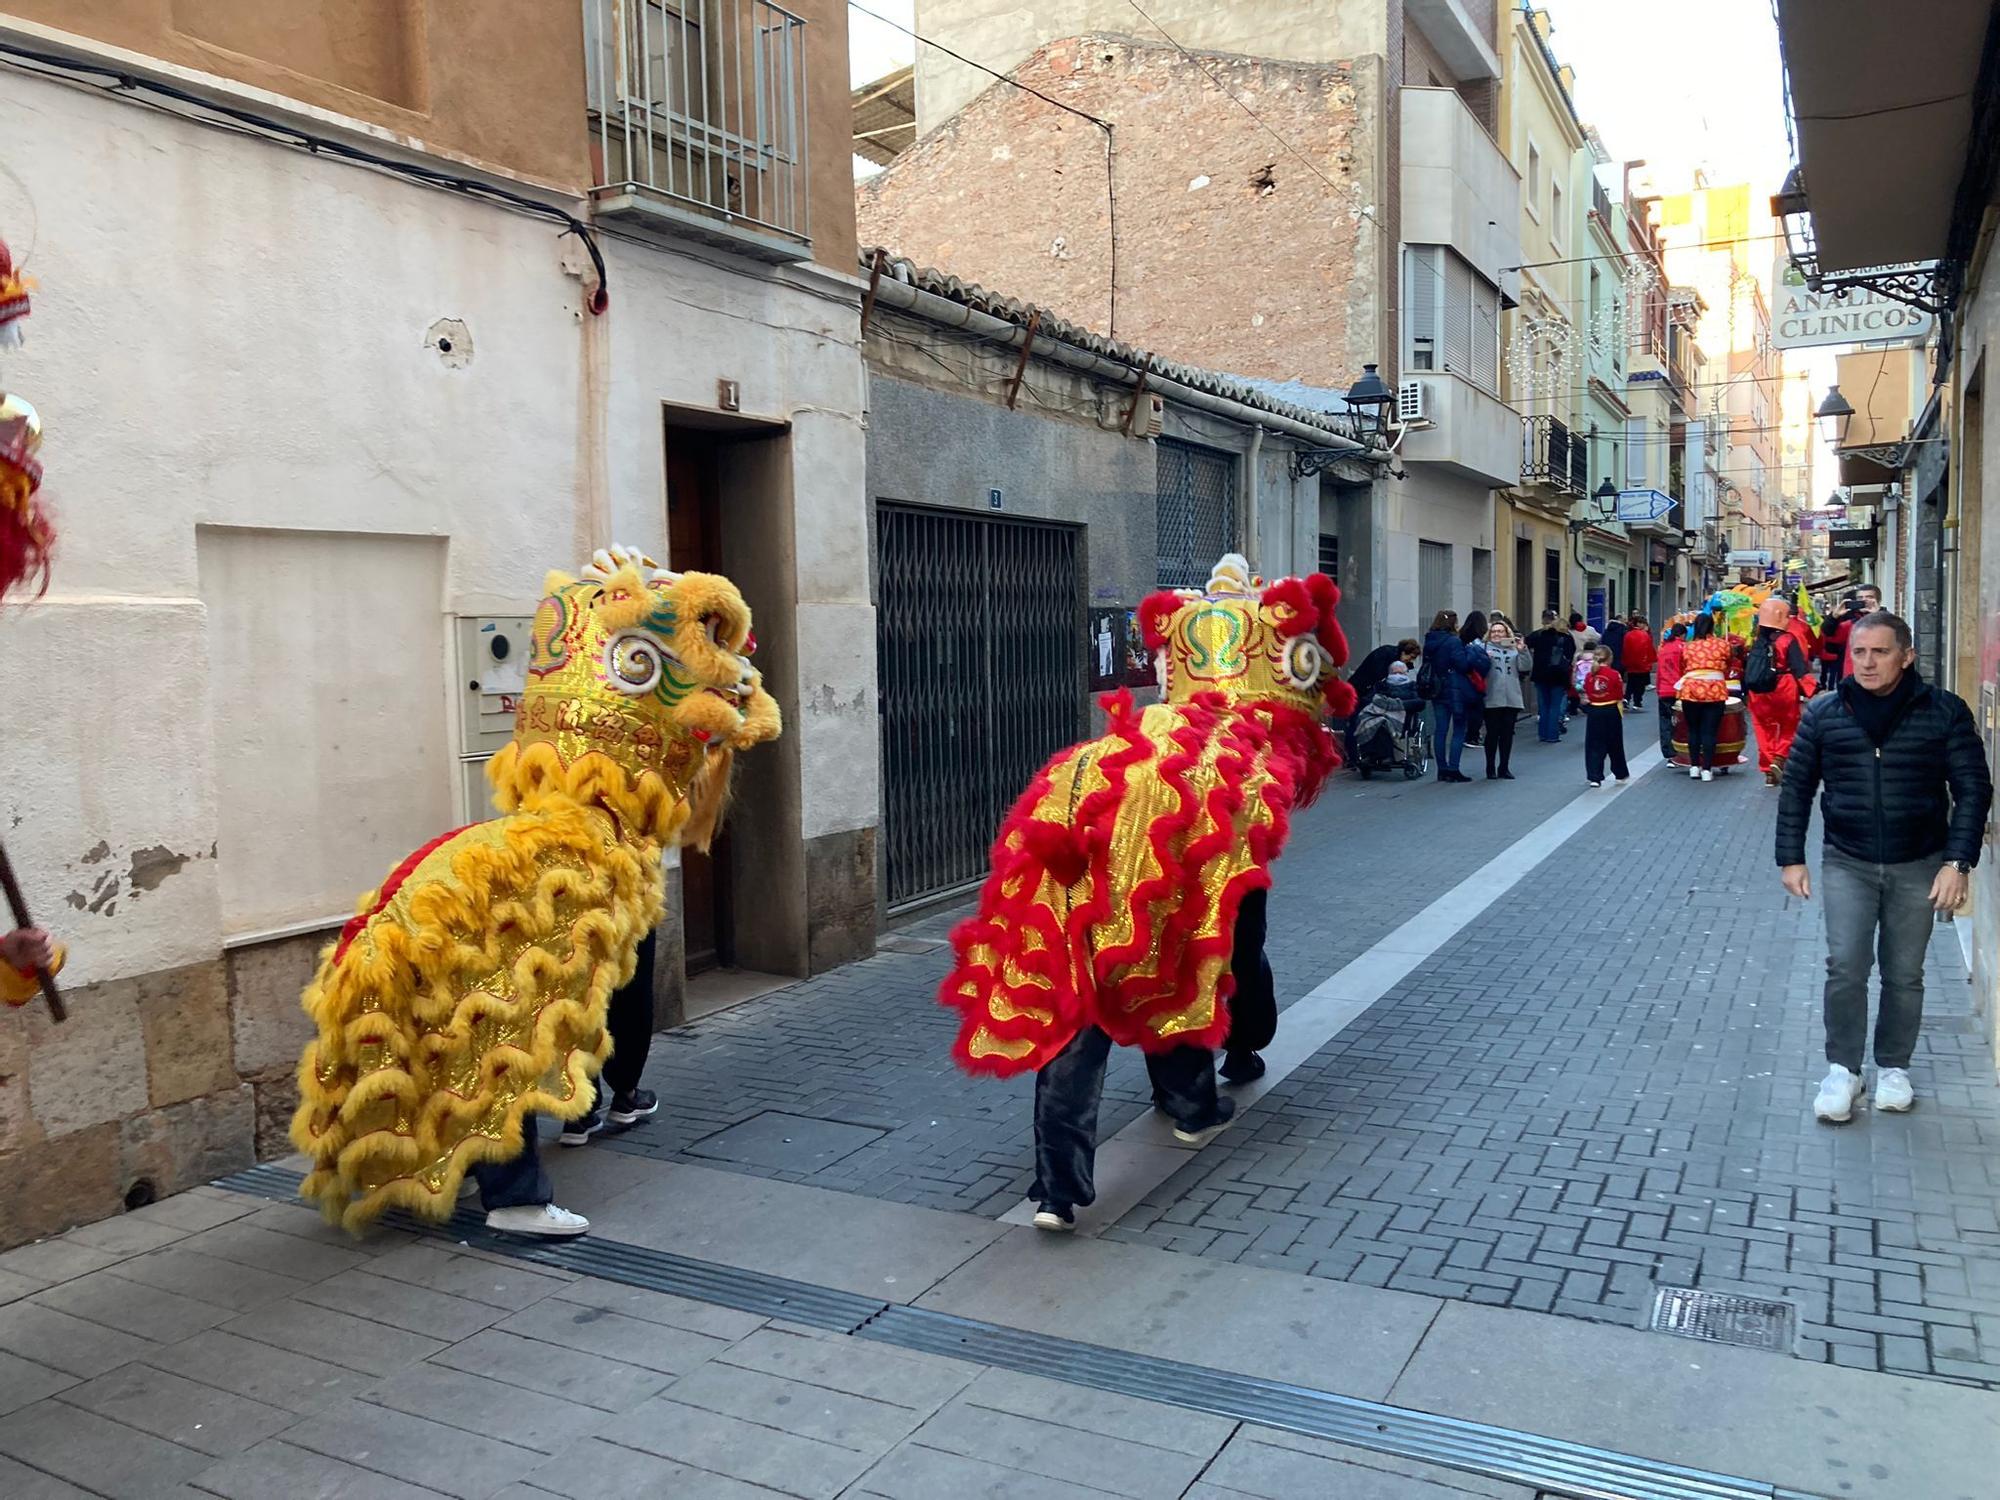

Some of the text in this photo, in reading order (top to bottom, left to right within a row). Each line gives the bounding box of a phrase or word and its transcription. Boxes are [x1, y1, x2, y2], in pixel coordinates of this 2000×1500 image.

[1782, 286, 1910, 315] ANALIS
[1779, 306, 1923, 338] CLINICOS
[727, 383, 737, 407] 1
